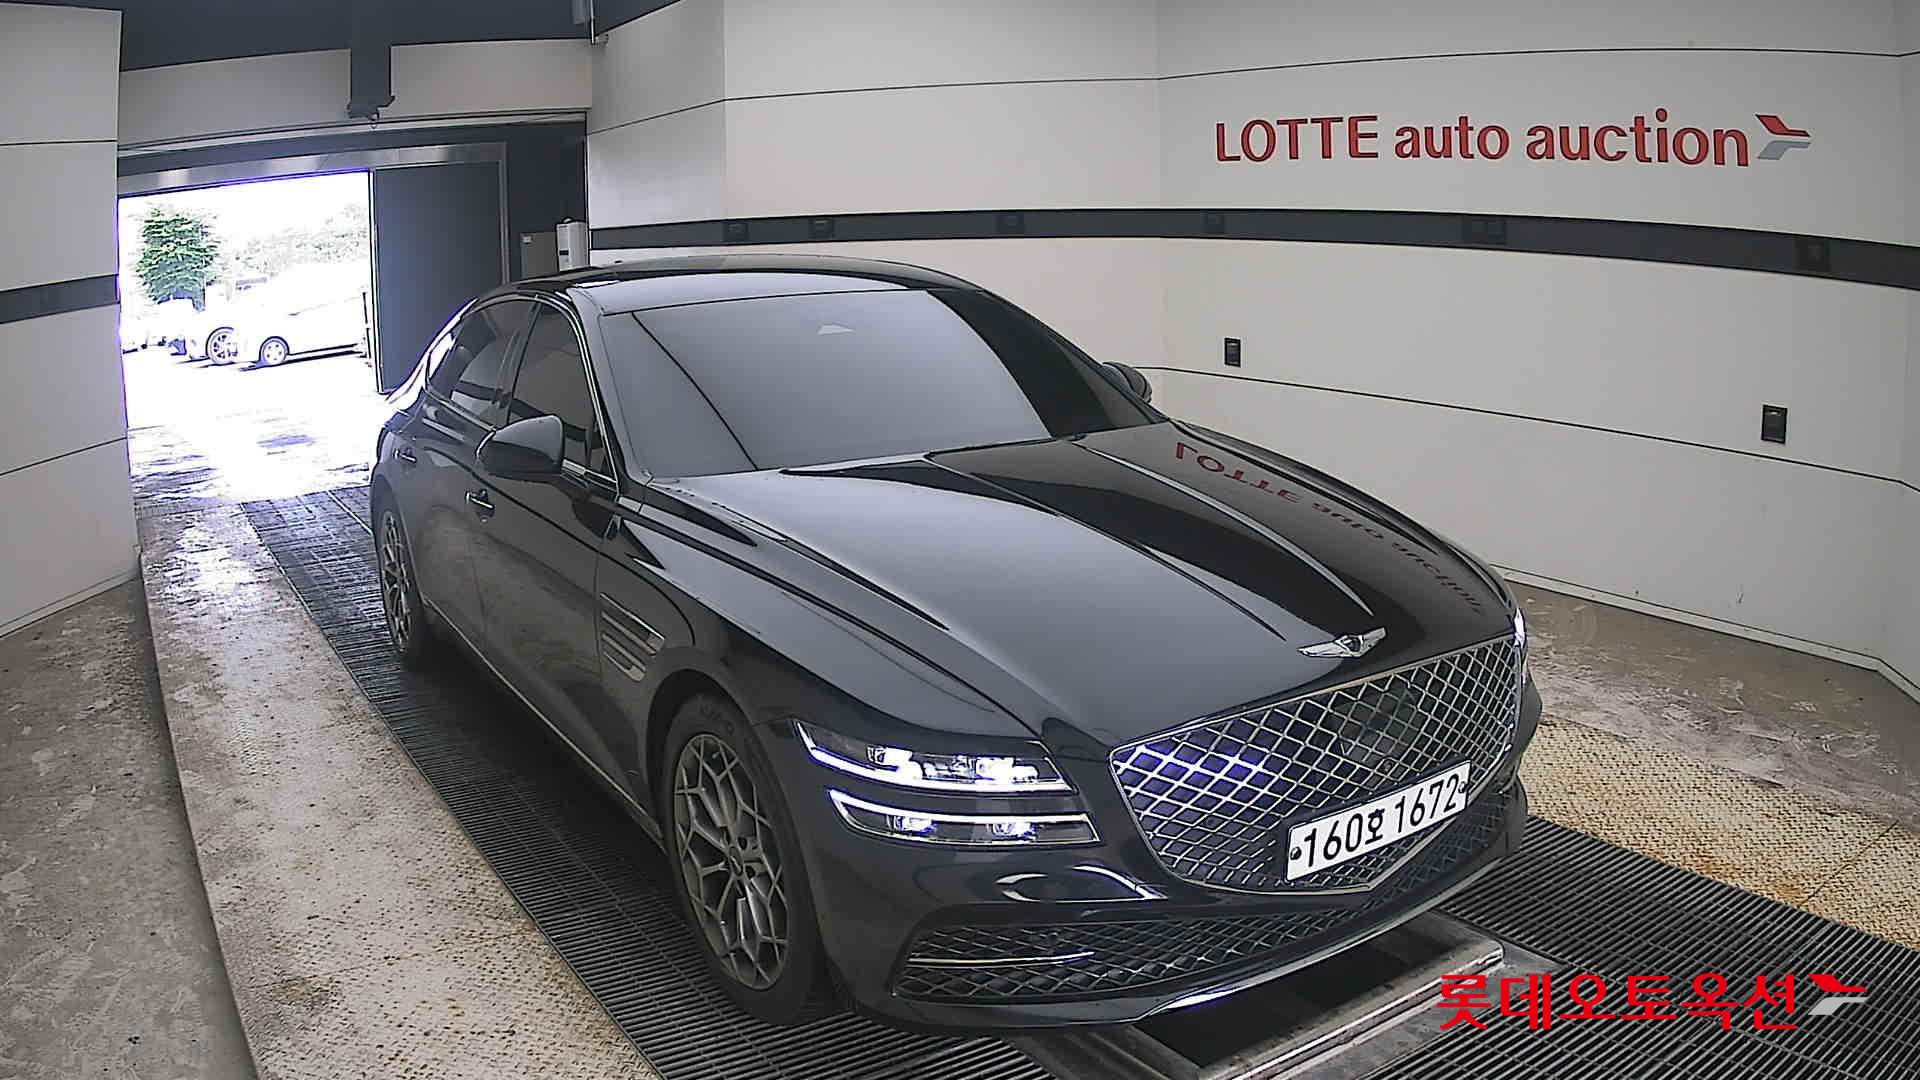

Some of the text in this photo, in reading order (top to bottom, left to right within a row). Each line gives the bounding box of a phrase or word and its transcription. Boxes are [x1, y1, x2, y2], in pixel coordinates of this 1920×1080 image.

[1216, 107, 1750, 167] LOTTE auto auction
[1303, 773, 1460, 868] 160호 1672
